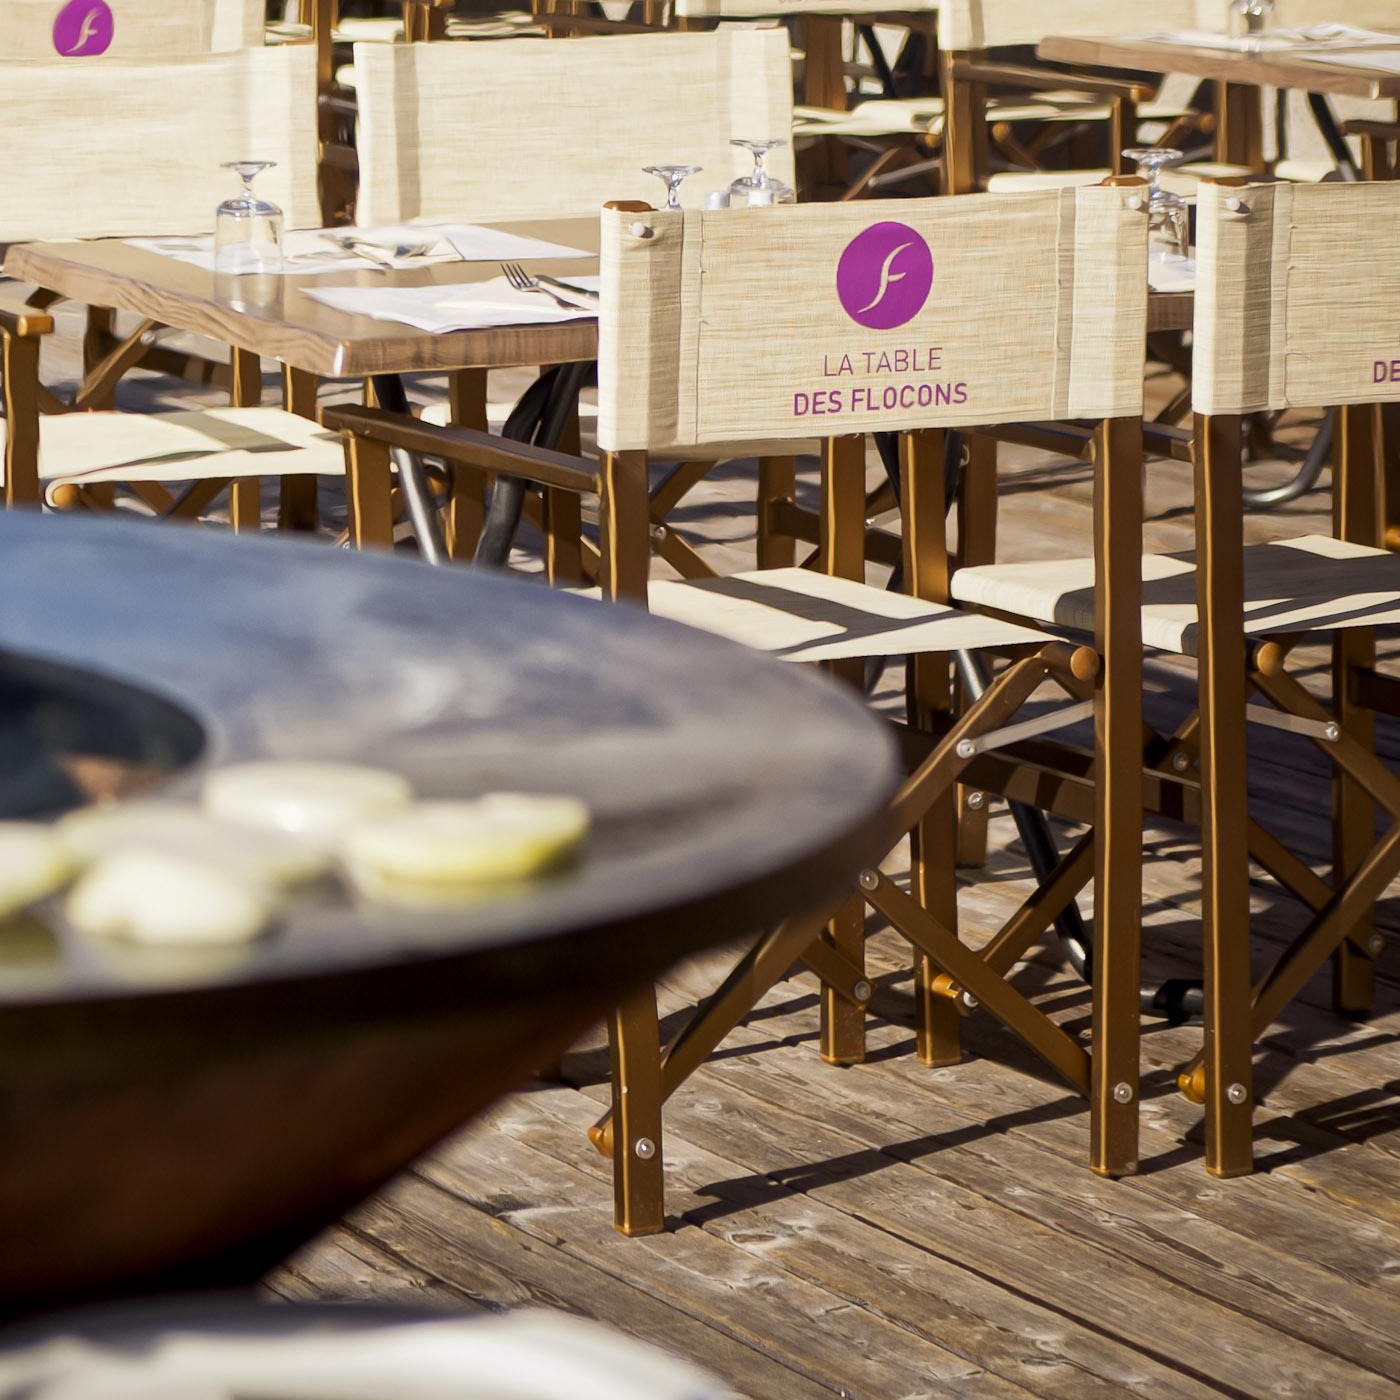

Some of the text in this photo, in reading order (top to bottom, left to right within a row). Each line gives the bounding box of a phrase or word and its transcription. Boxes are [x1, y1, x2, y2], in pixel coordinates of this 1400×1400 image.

[823, 347, 944, 377] LA TABLE
[793, 382, 969, 417] DES FLOCONS
